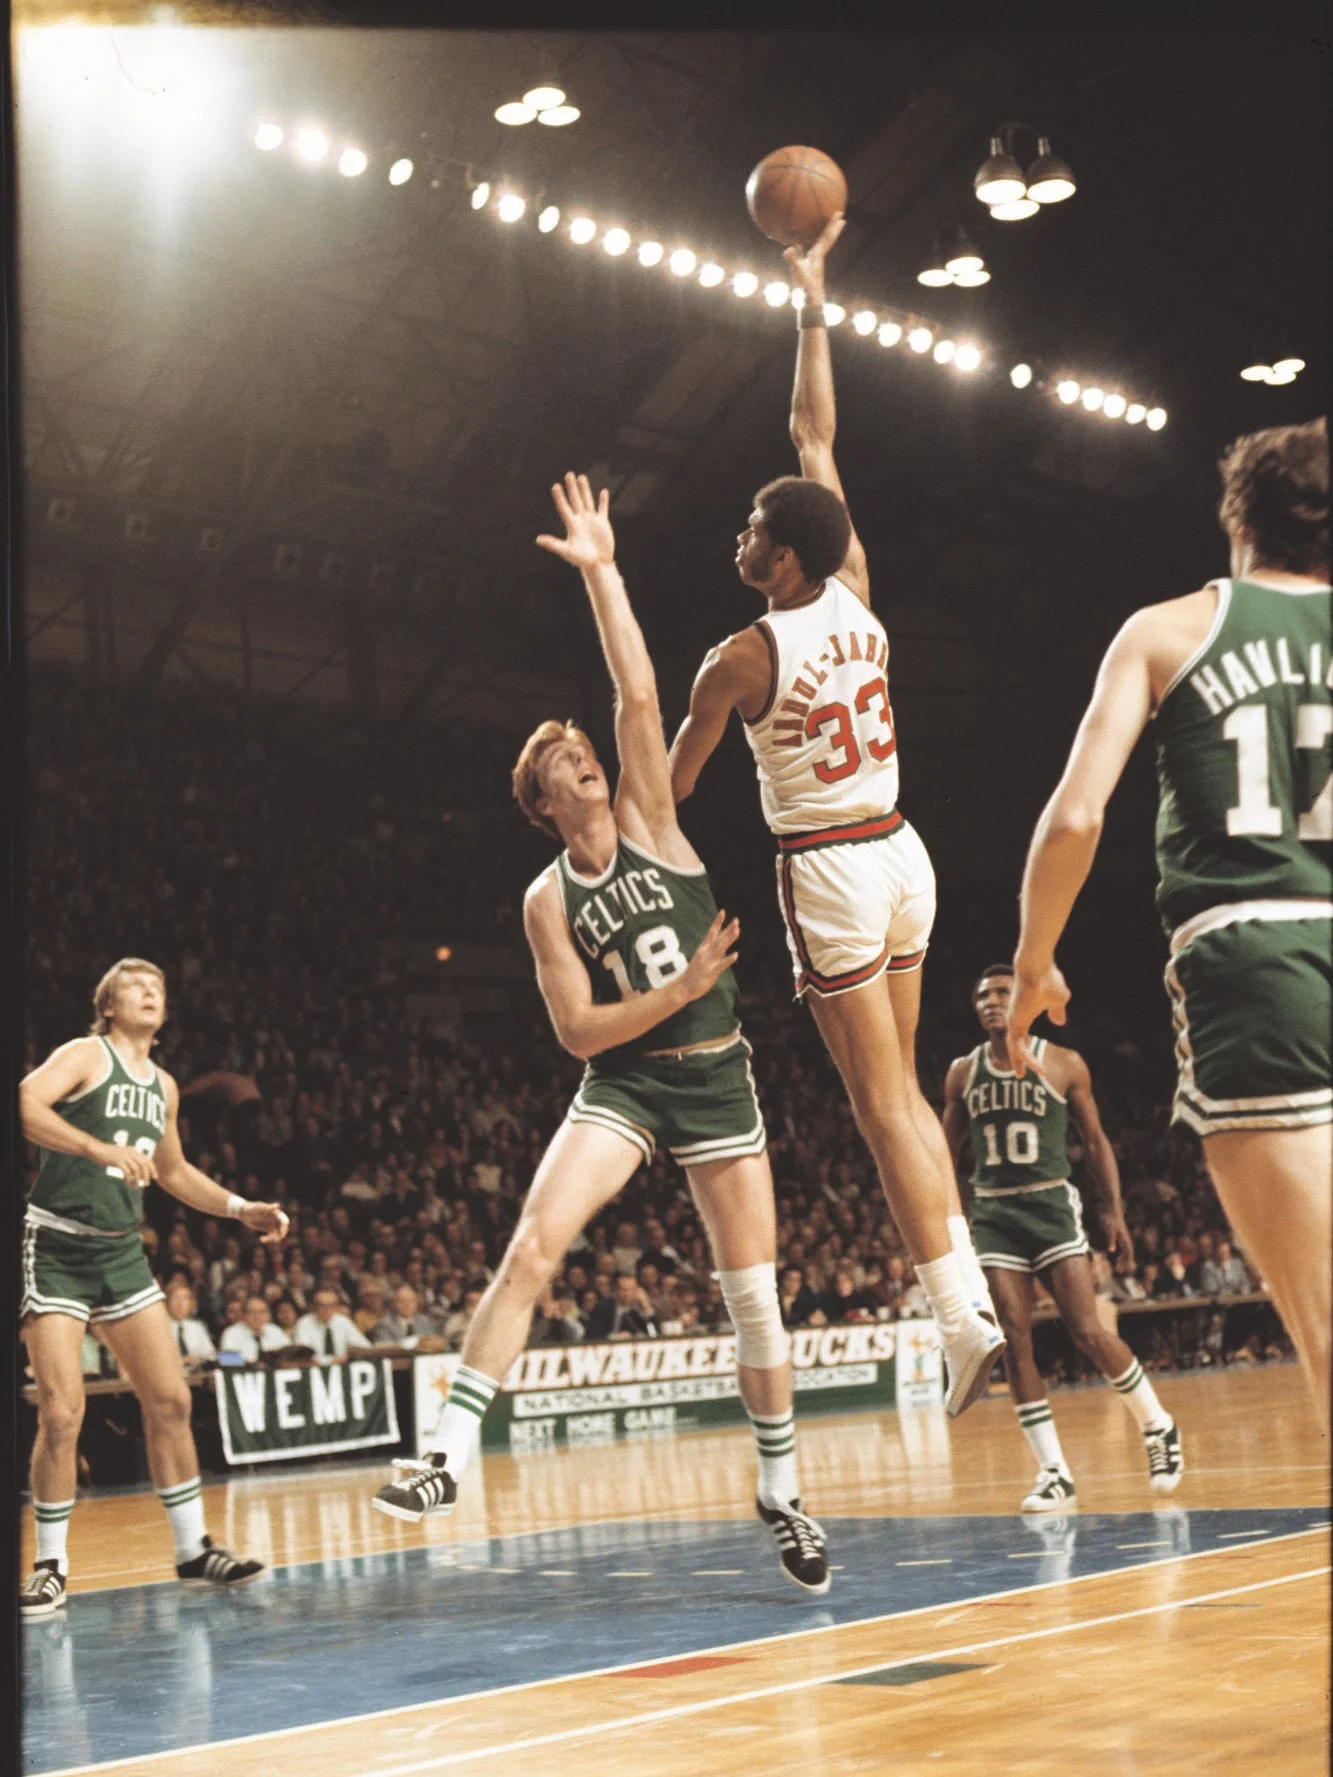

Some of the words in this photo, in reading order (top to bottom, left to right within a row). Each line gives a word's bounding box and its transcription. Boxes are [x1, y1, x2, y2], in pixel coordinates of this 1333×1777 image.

[804, 676, 897, 784] 33
[573, 867, 675, 960] CELTICS
[602, 924, 689, 996] 18
[105, 1083, 166, 1136] CELTIC
[967, 1080, 1047, 1119] CELTICS
[983, 1121, 1039, 1166] 10
[791, 1321, 897, 1369] UCKS
[231, 1360, 377, 1434] WEMP
[640, 1379, 738, 1400] BASKETBA
